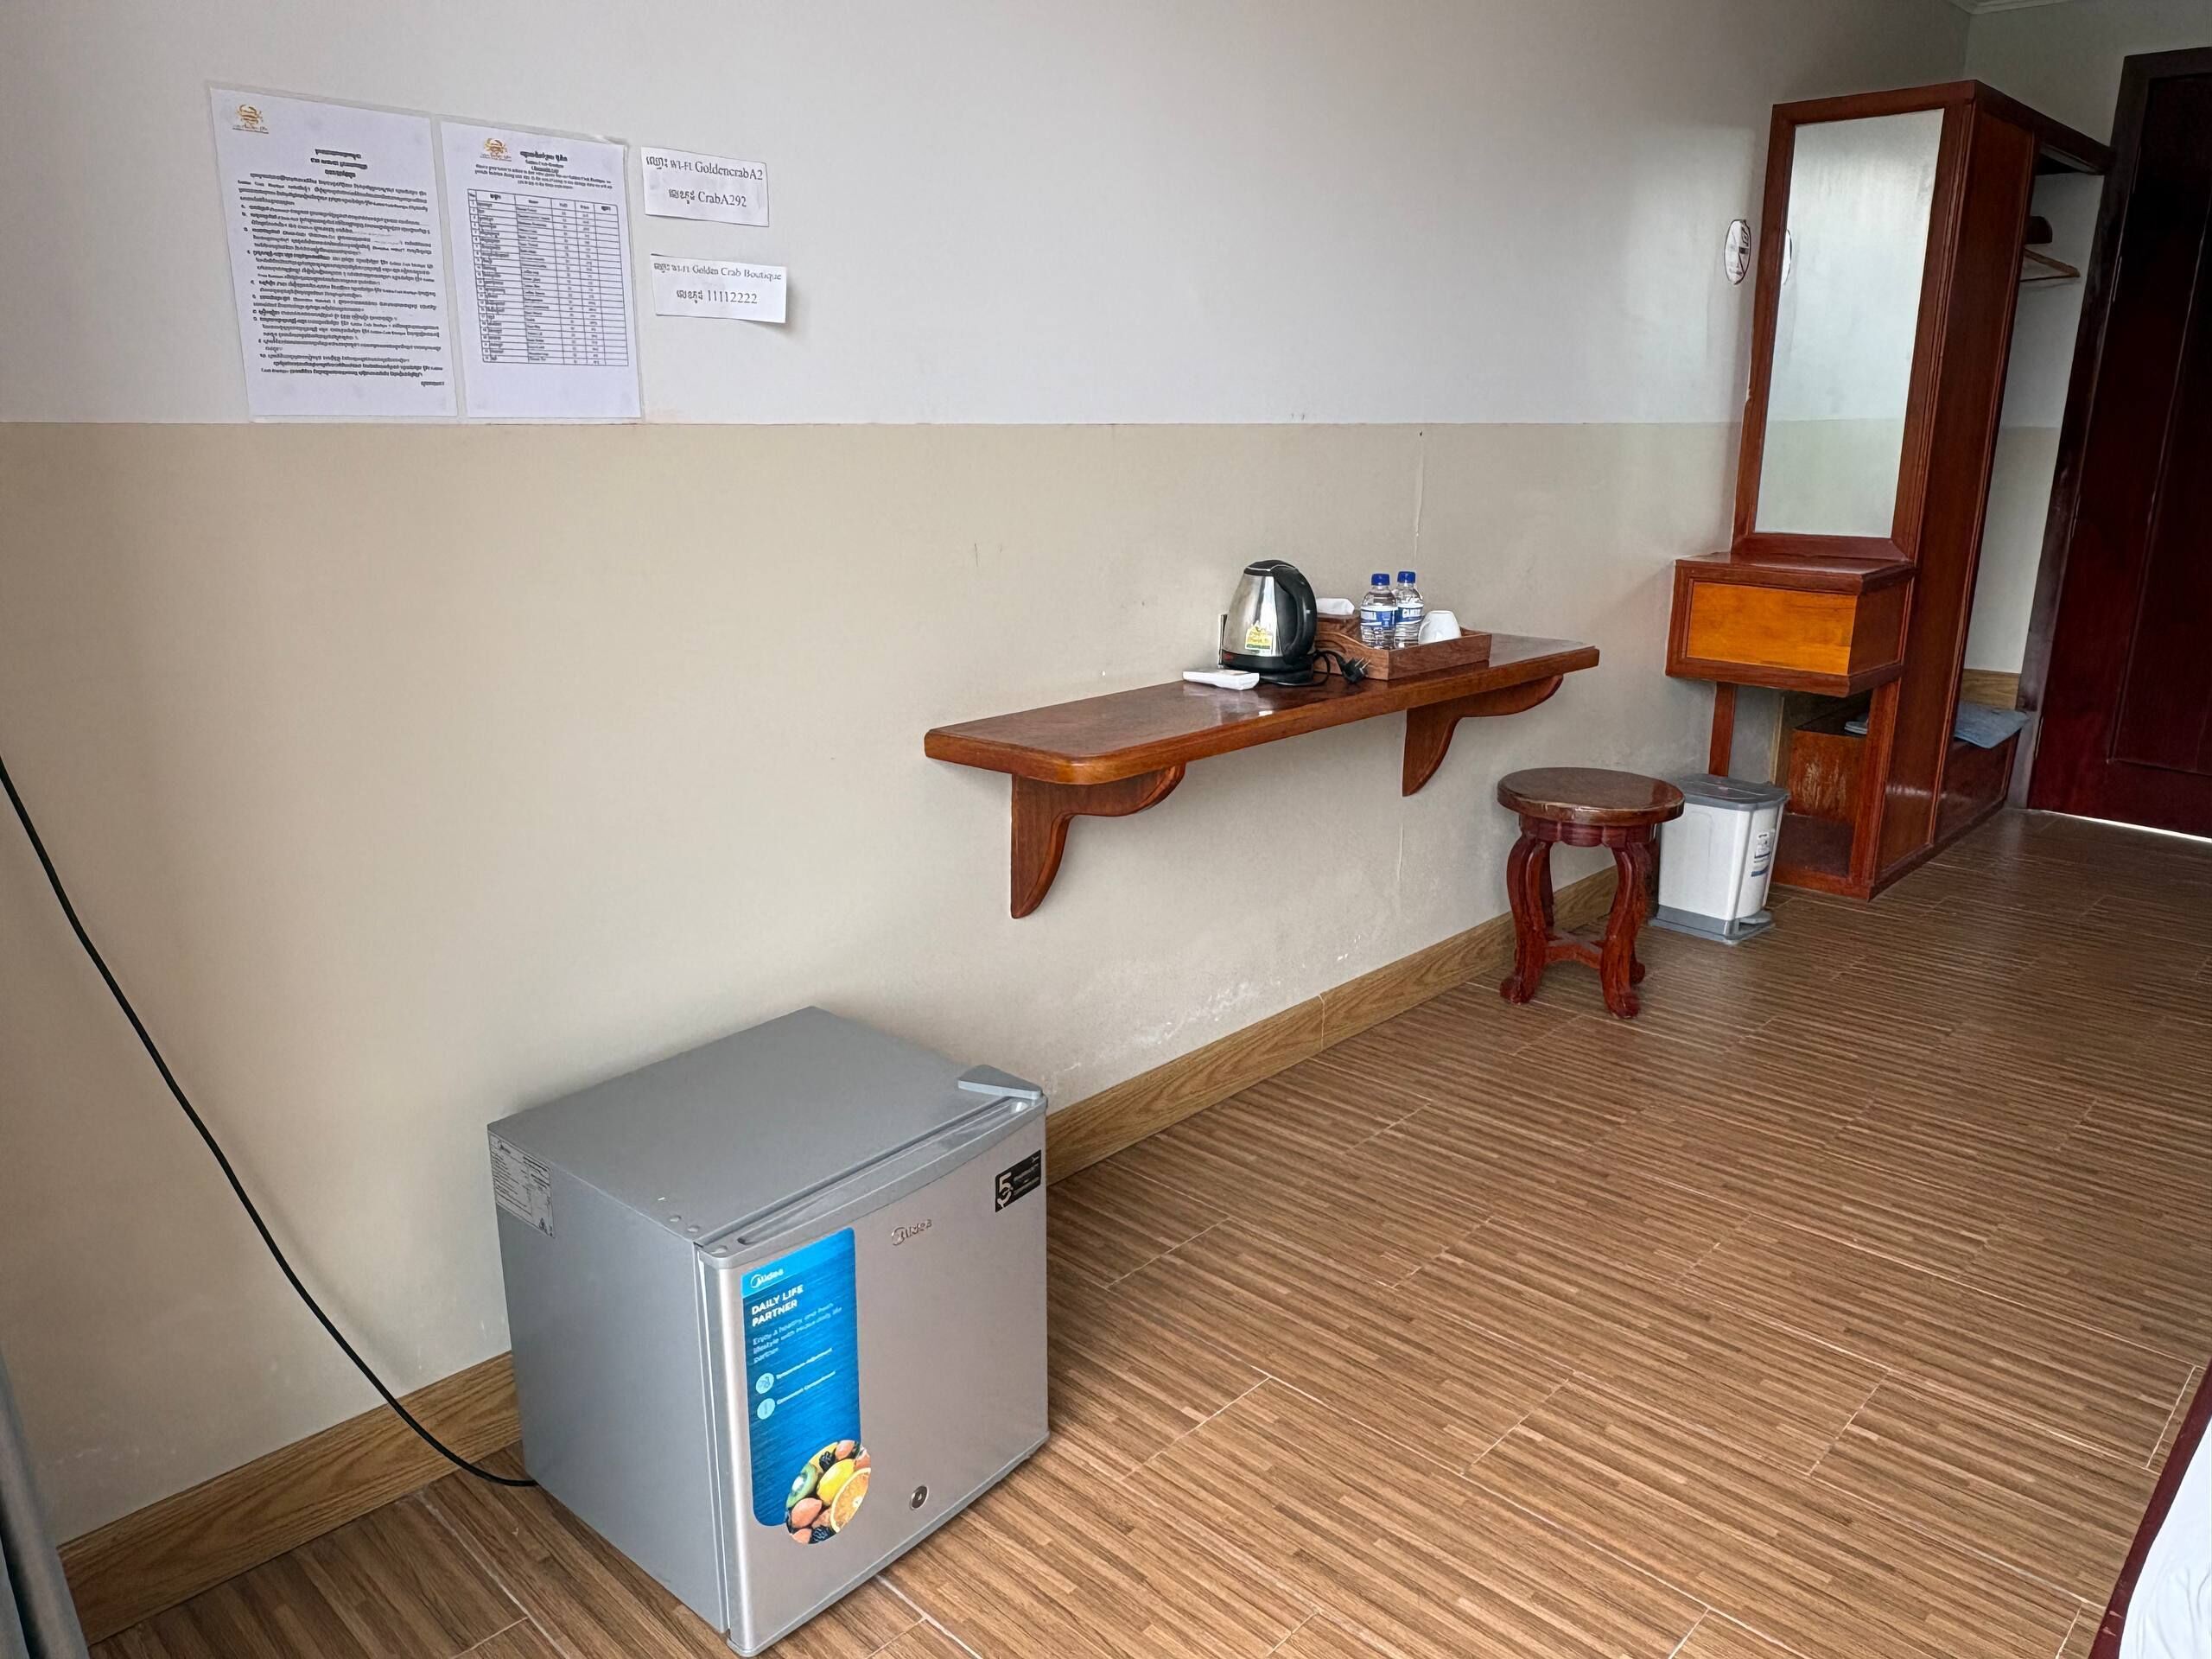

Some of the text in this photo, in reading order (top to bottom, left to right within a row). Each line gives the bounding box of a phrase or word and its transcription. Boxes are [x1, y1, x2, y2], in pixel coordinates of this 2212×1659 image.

[698, 191, 747, 207] CrabA292
[692, 264, 719, 275] Golden
[721, 267, 741, 277] Crab
[744, 269, 782, 282] Boutique
[708, 289, 758, 304] 11112222
[892, 1218, 932, 1246] Midea
[750, 1268, 784, 1288] Midea
[751, 1284, 804, 1315] DAILY LIFE
[752, 1299, 798, 1327] PARTNER
